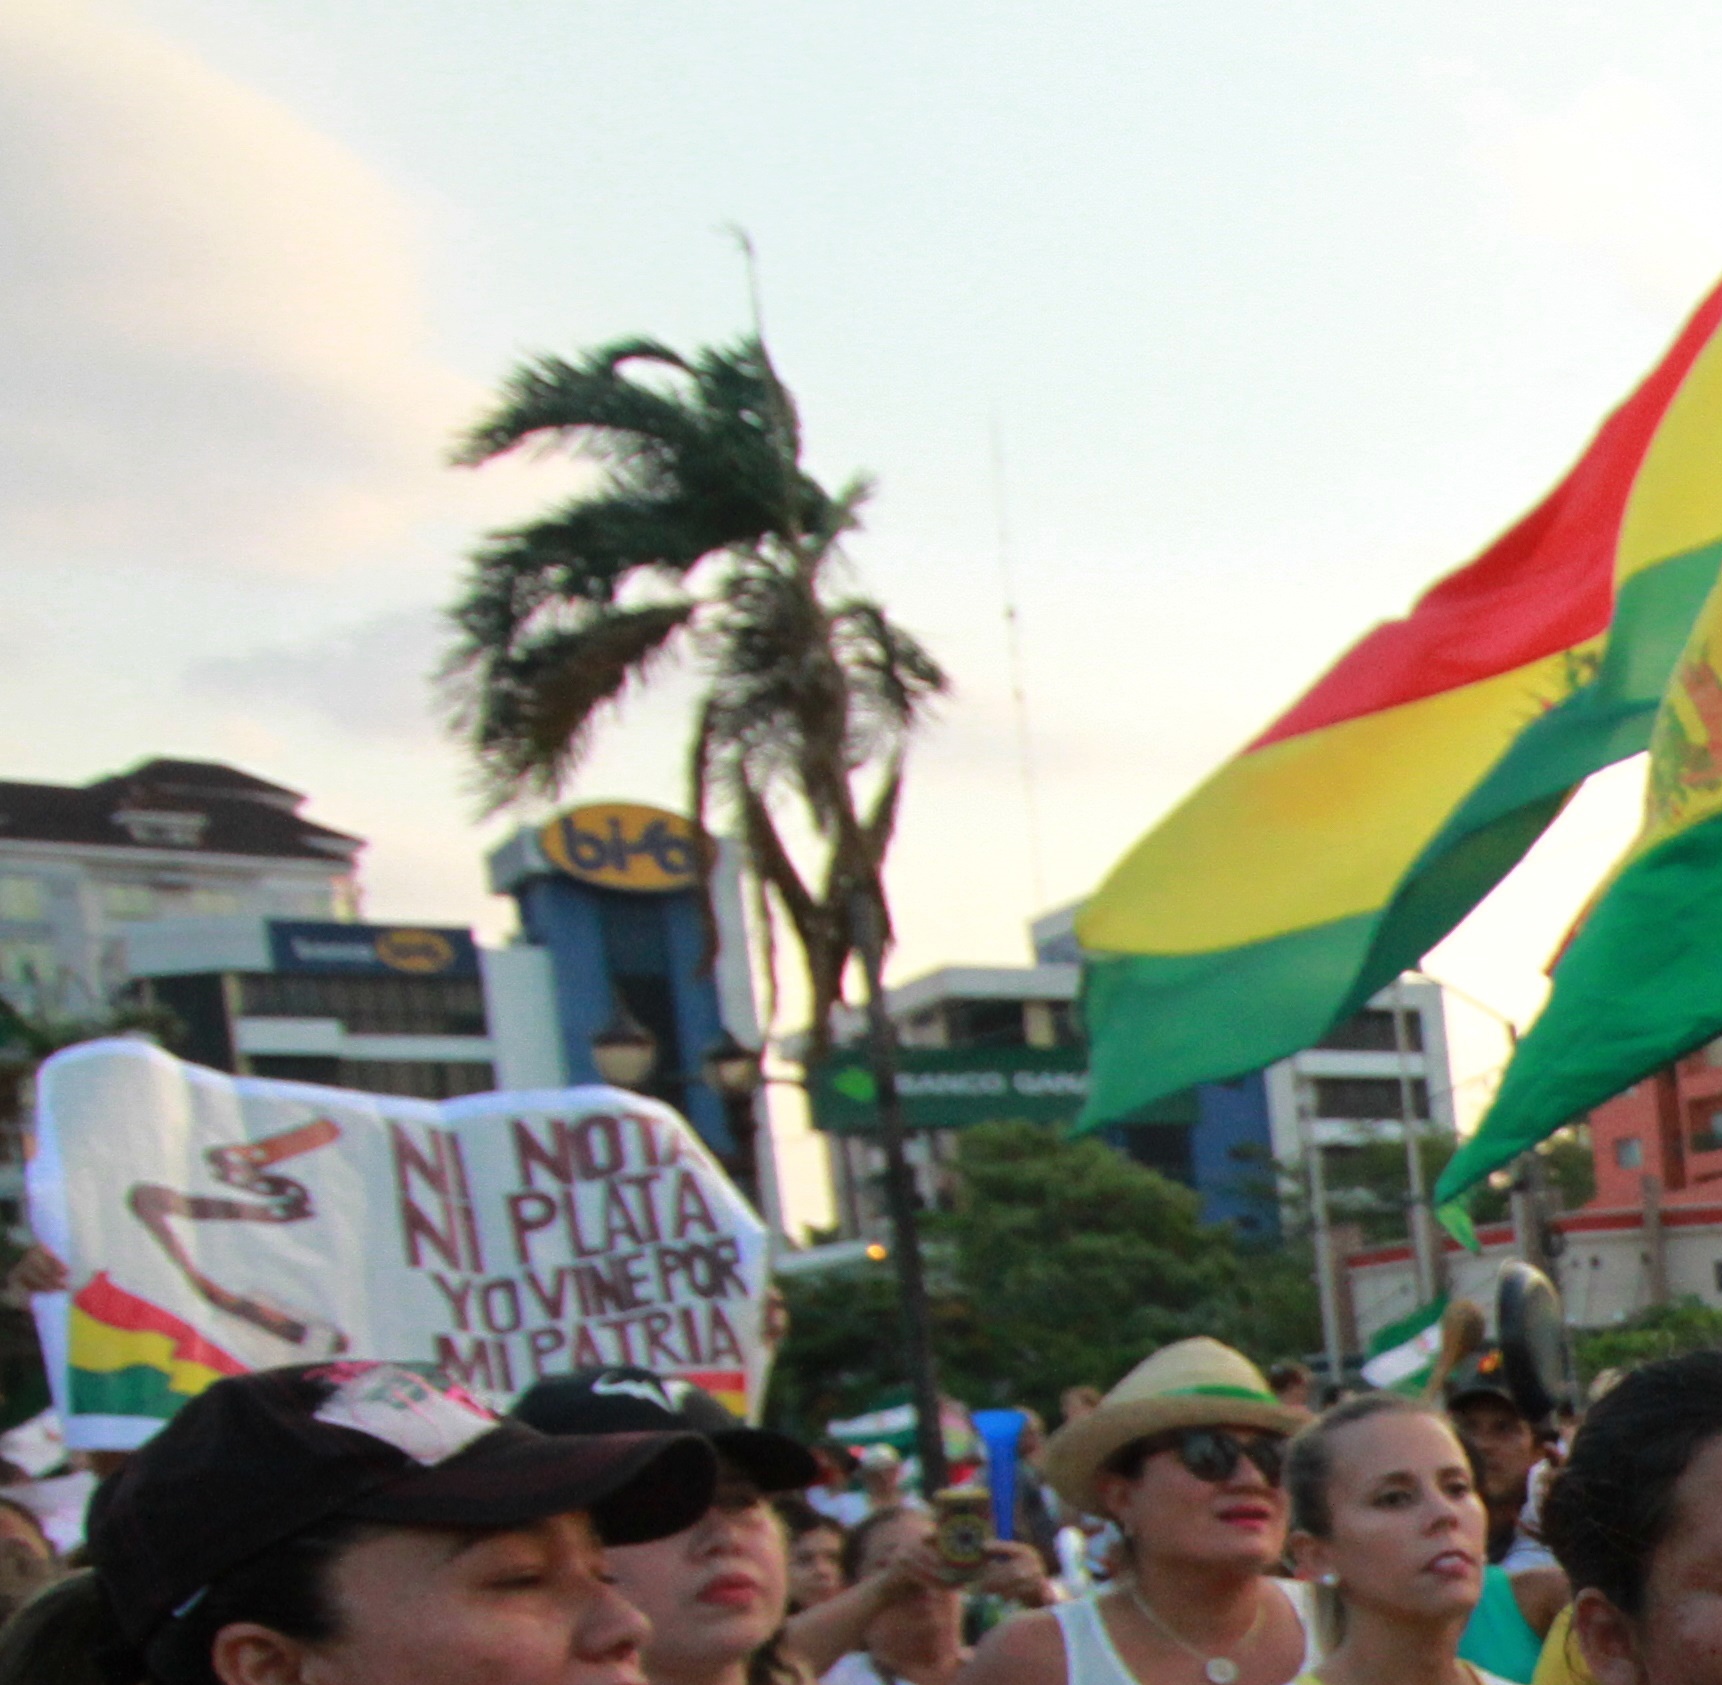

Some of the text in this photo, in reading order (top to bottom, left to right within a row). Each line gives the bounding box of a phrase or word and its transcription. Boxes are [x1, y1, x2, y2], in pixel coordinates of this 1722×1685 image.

[388, 1117, 470, 1209] NI
[403, 1170, 719, 1274] NI PLATA
[432, 1236, 753, 1335] YO VINE POR
[436, 1304, 746, 1393] MI PATRIA
